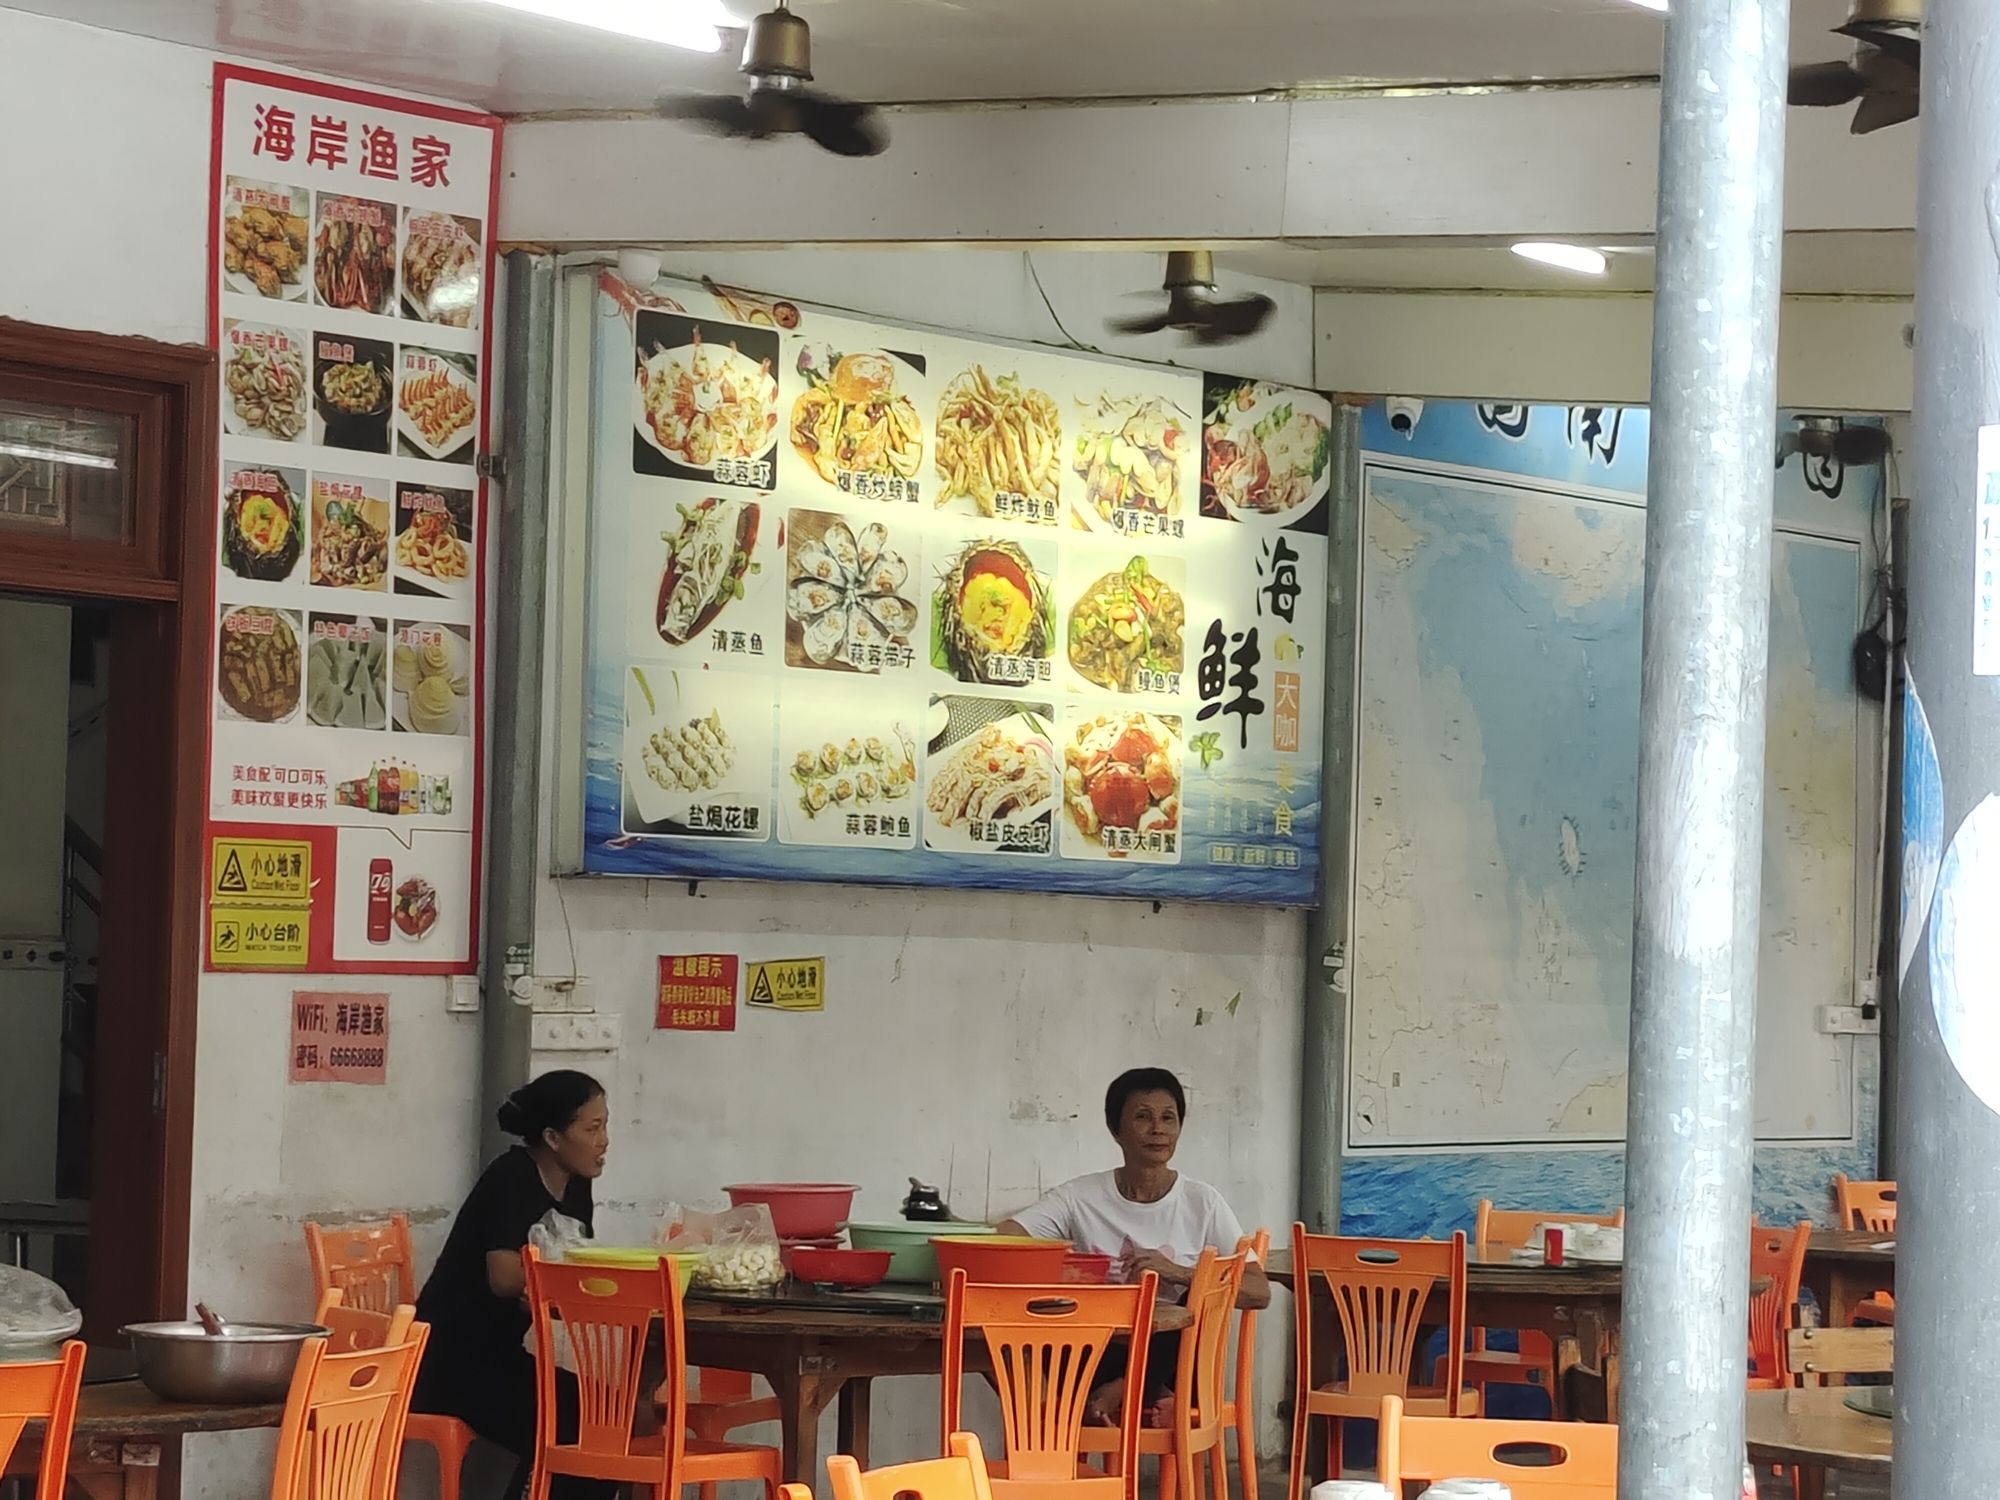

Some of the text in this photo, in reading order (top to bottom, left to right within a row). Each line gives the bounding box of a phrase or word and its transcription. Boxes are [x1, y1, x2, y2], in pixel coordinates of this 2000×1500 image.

[253, 103, 452, 188] 海岸渔家
[714, 458, 771, 488] 蒜蓉虾
[711, 628, 765, 655] 清蒸鱼
[1196, 536, 1302, 750] 海鲜
[850, 643, 916, 670] 蒜蓉带子
[990, 655, 1051, 682] 清蒸海胆
[1139, 670, 1181, 695] 鳗鱼煲
[1276, 674, 1299, 747] 大咖
[231, 788, 327, 810] 美味欢聚更快乐
[688, 804, 760, 831] 盐焗花螺
[845, 814, 912, 839] 蒜蓉鲍鱼
[969, 821, 1050, 846] 椒盐皮皮虾
[1103, 825, 1176, 854] 清蒸大闸蟹
[251, 851, 302, 878] 小心地滑
[246, 922, 300, 943] 小心台阶
[672, 956, 723, 978] 温馨提示
[776, 966, 817, 989] 小心地滑
